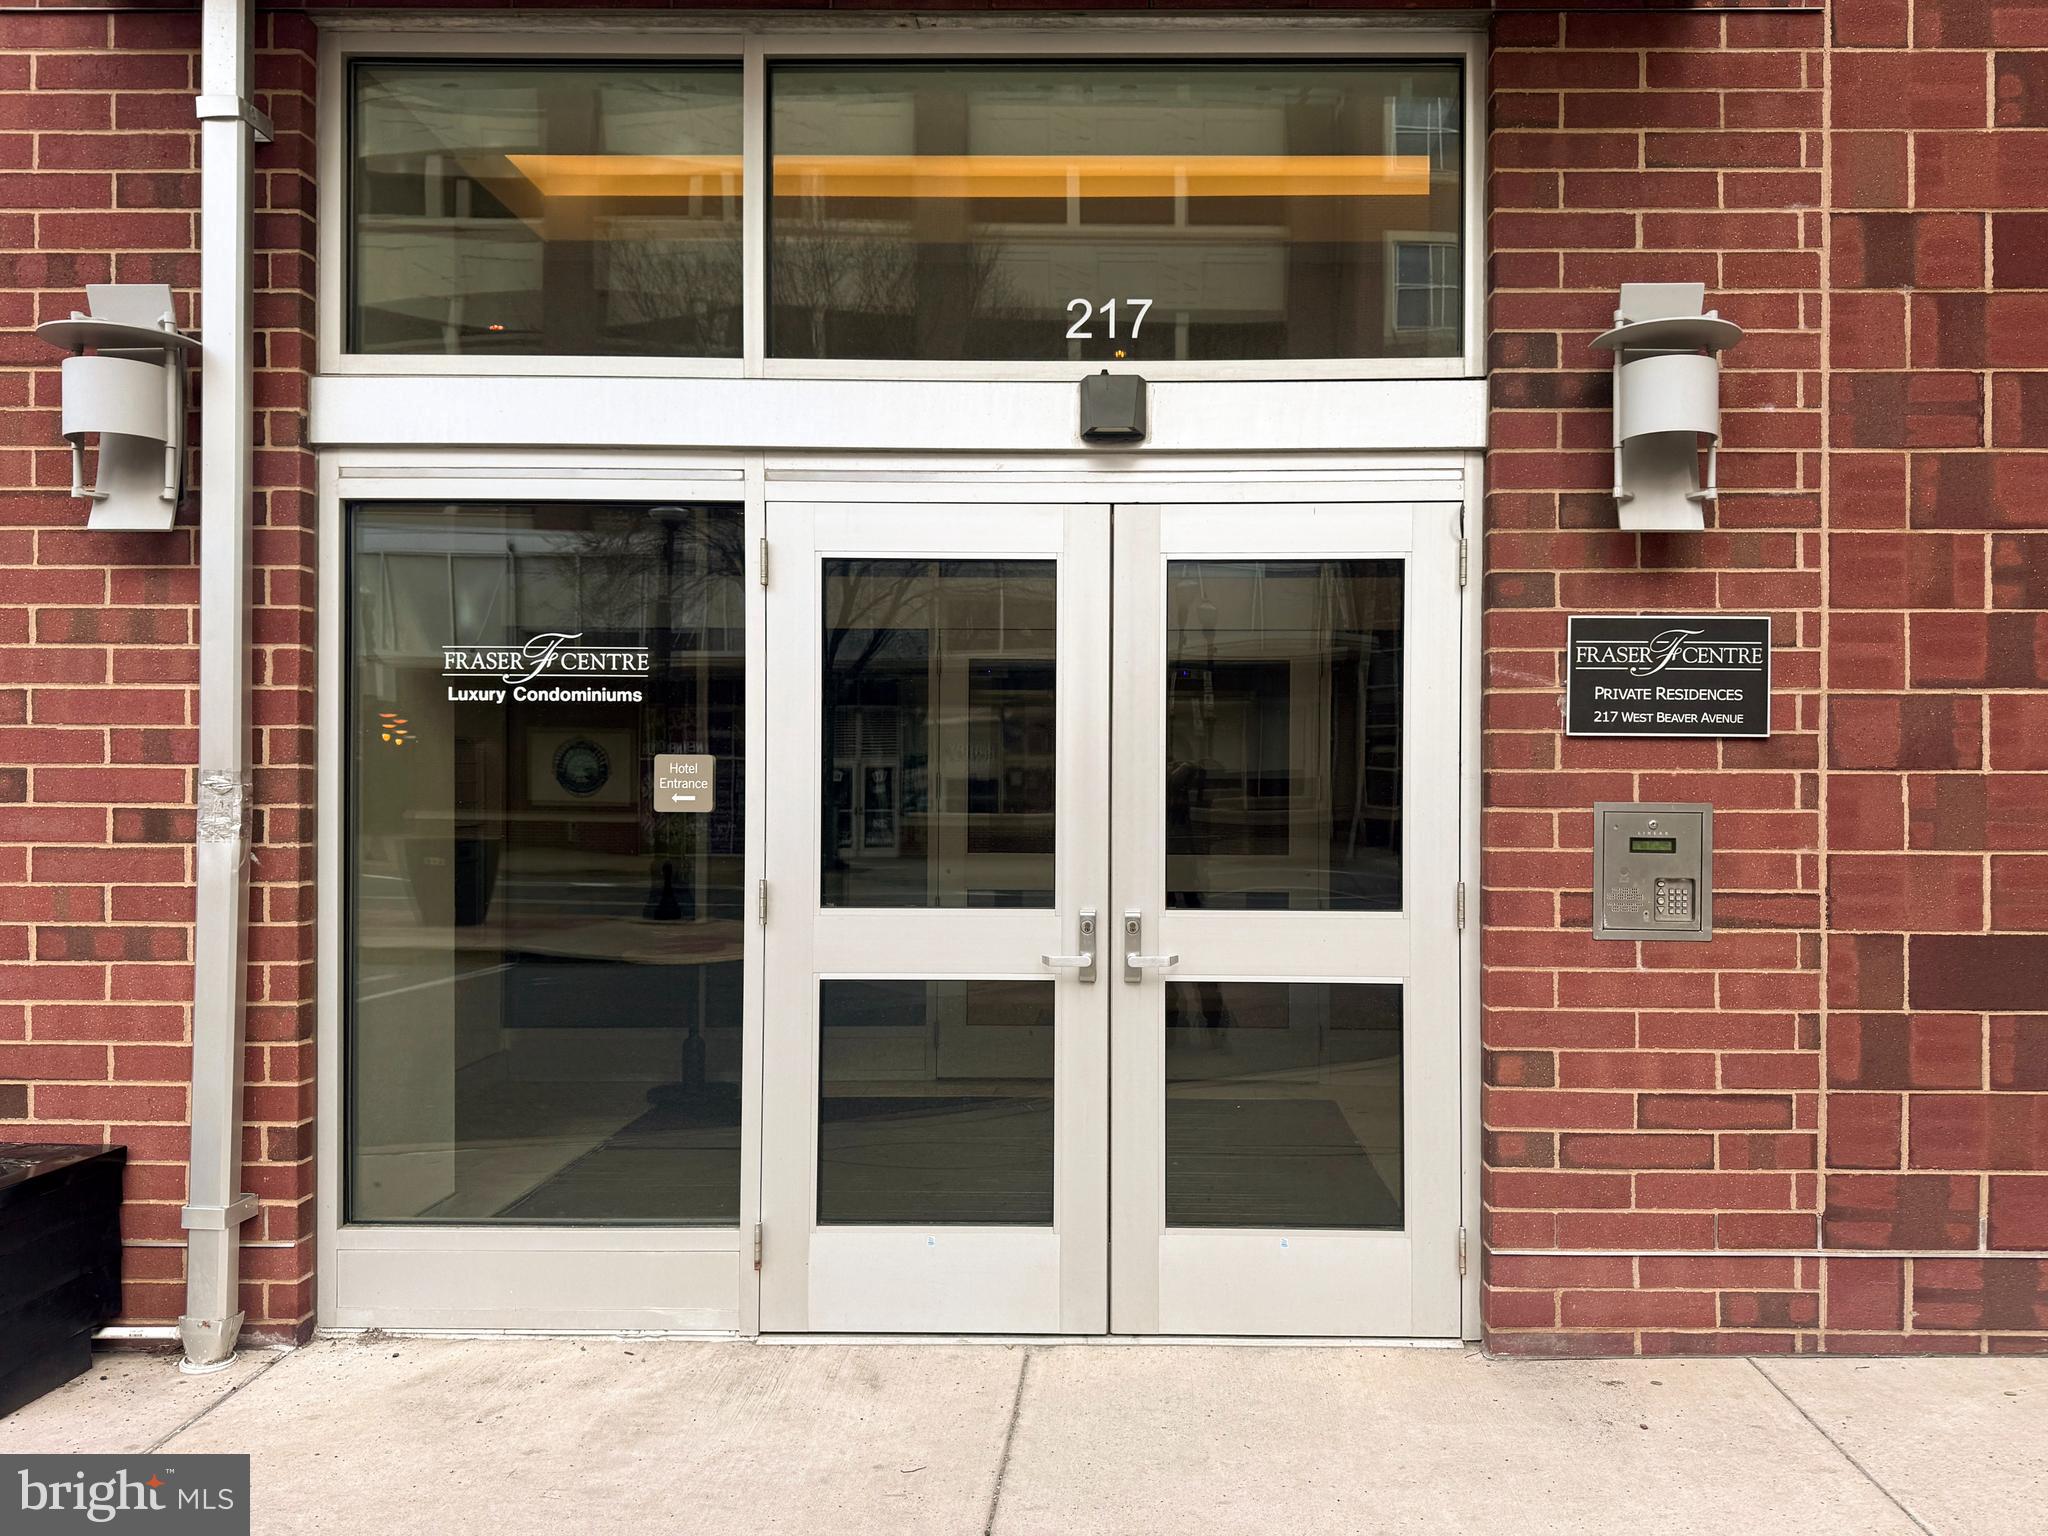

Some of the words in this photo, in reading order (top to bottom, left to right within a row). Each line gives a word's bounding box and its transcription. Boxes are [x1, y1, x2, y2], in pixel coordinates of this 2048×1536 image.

[1065, 298, 1153, 339] 217
[444, 651, 524, 671] FRASER
[560, 652, 650, 672] CENTRE
[1575, 646, 1653, 664] FRASER
[1682, 646, 1764, 665] CENTRE
[448, 686, 506, 704] Luxury
[513, 687, 643, 703] Condominiums
[1594, 686, 1652, 701] PRIVATE
[1656, 686, 1744, 702] RESIDENCES
[1593, 710, 1618, 723] 217
[1621, 711, 1654, 723] WEST
[1656, 711, 1698, 724] BEAVER
[1701, 712, 1744, 724] AVENUE
[669, 762, 699, 775] Hotel
[659, 778, 709, 790] Entrance
